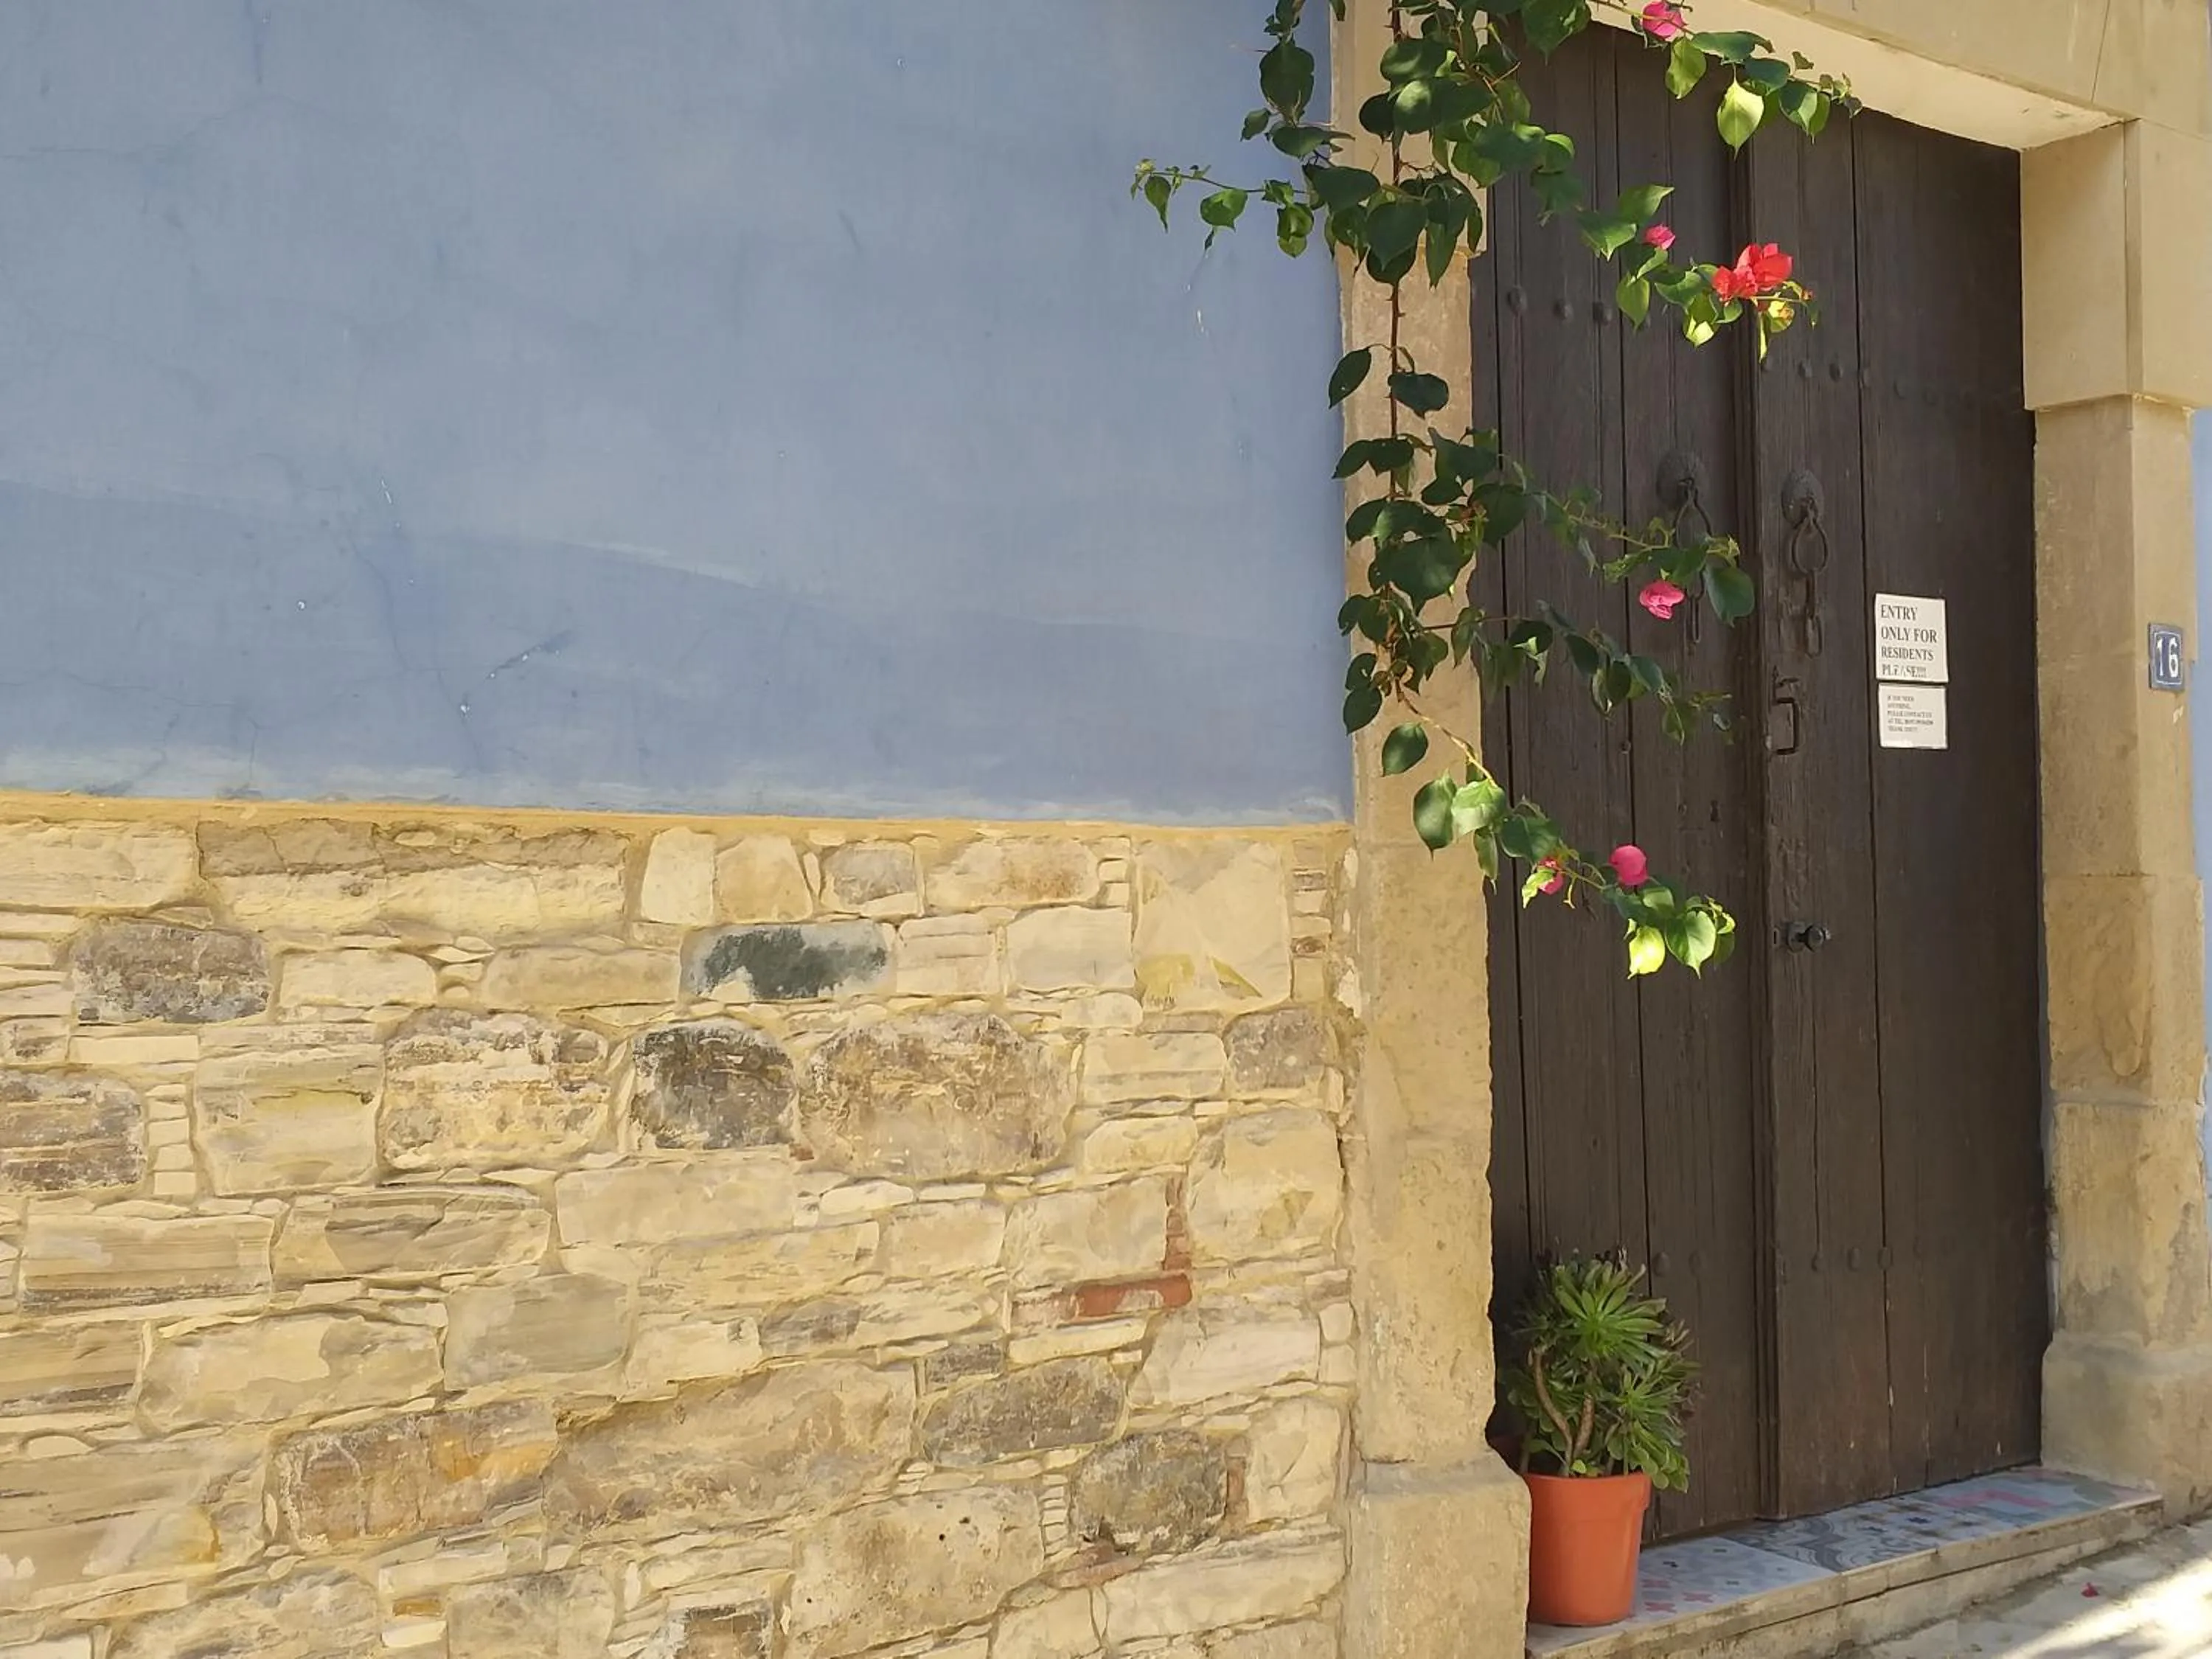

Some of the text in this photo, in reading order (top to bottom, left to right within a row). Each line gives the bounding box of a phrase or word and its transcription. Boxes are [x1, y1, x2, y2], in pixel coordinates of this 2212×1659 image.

[1881, 604, 1918, 621] ENTRY
[1881, 626, 1937, 644] ONLY FOR
[1881, 646, 1935, 661] RESIDENTS
[2157, 636, 2179, 678] 16
